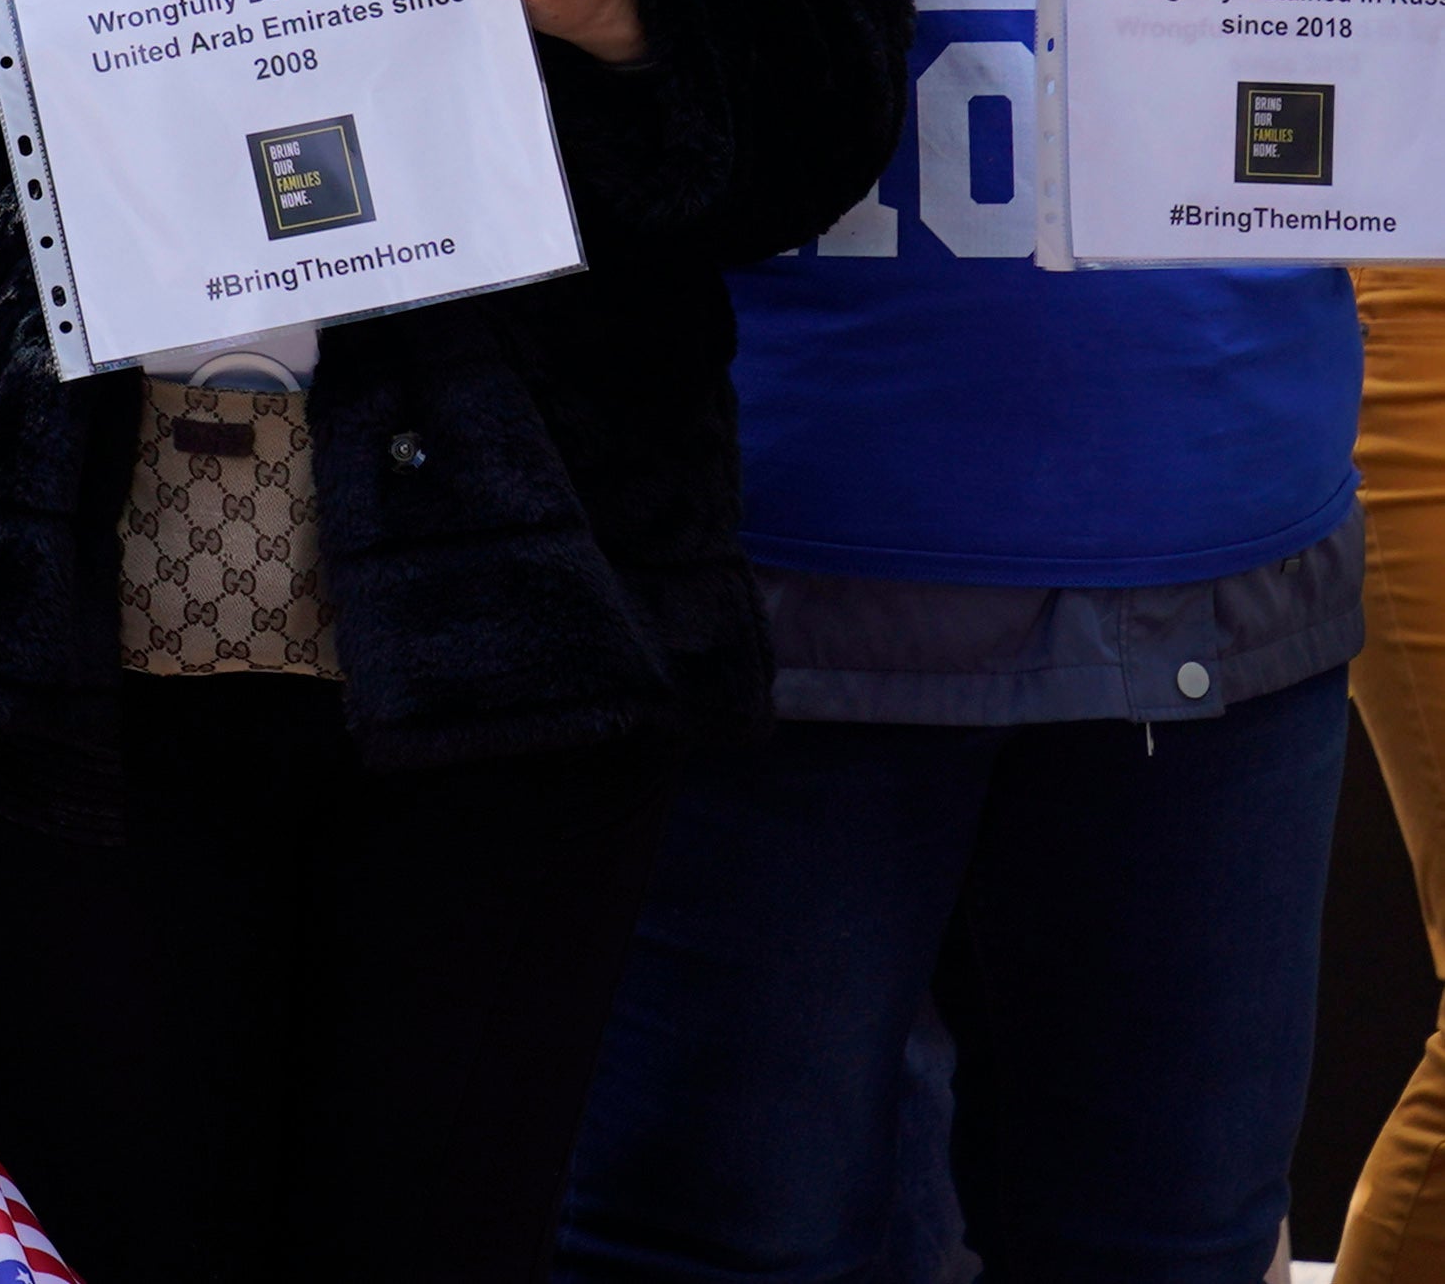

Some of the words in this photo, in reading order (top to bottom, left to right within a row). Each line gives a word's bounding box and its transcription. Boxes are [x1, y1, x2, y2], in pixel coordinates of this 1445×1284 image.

[1222, 15, 1288, 36] since
[1296, 17, 1352, 38] 2018
[92, 37, 181, 74] United
[190, 24, 254, 54] Arab
[263, 0, 384, 40] Emirates
[254, 48, 319, 80] 2008
[1254, 96, 1282, 111] BRING
[1254, 113, 1272, 127] OUR
[1254, 129, 1293, 143] FAMILIES
[269, 141, 301, 160] BRING
[273, 159, 295, 176] OUR
[276, 171, 321, 192] FAMILIES
[280, 191, 312, 209] HOME.
[1170, 204, 1397, 232] #BringThemHome
[206, 237, 456, 301] #BringThemHome
